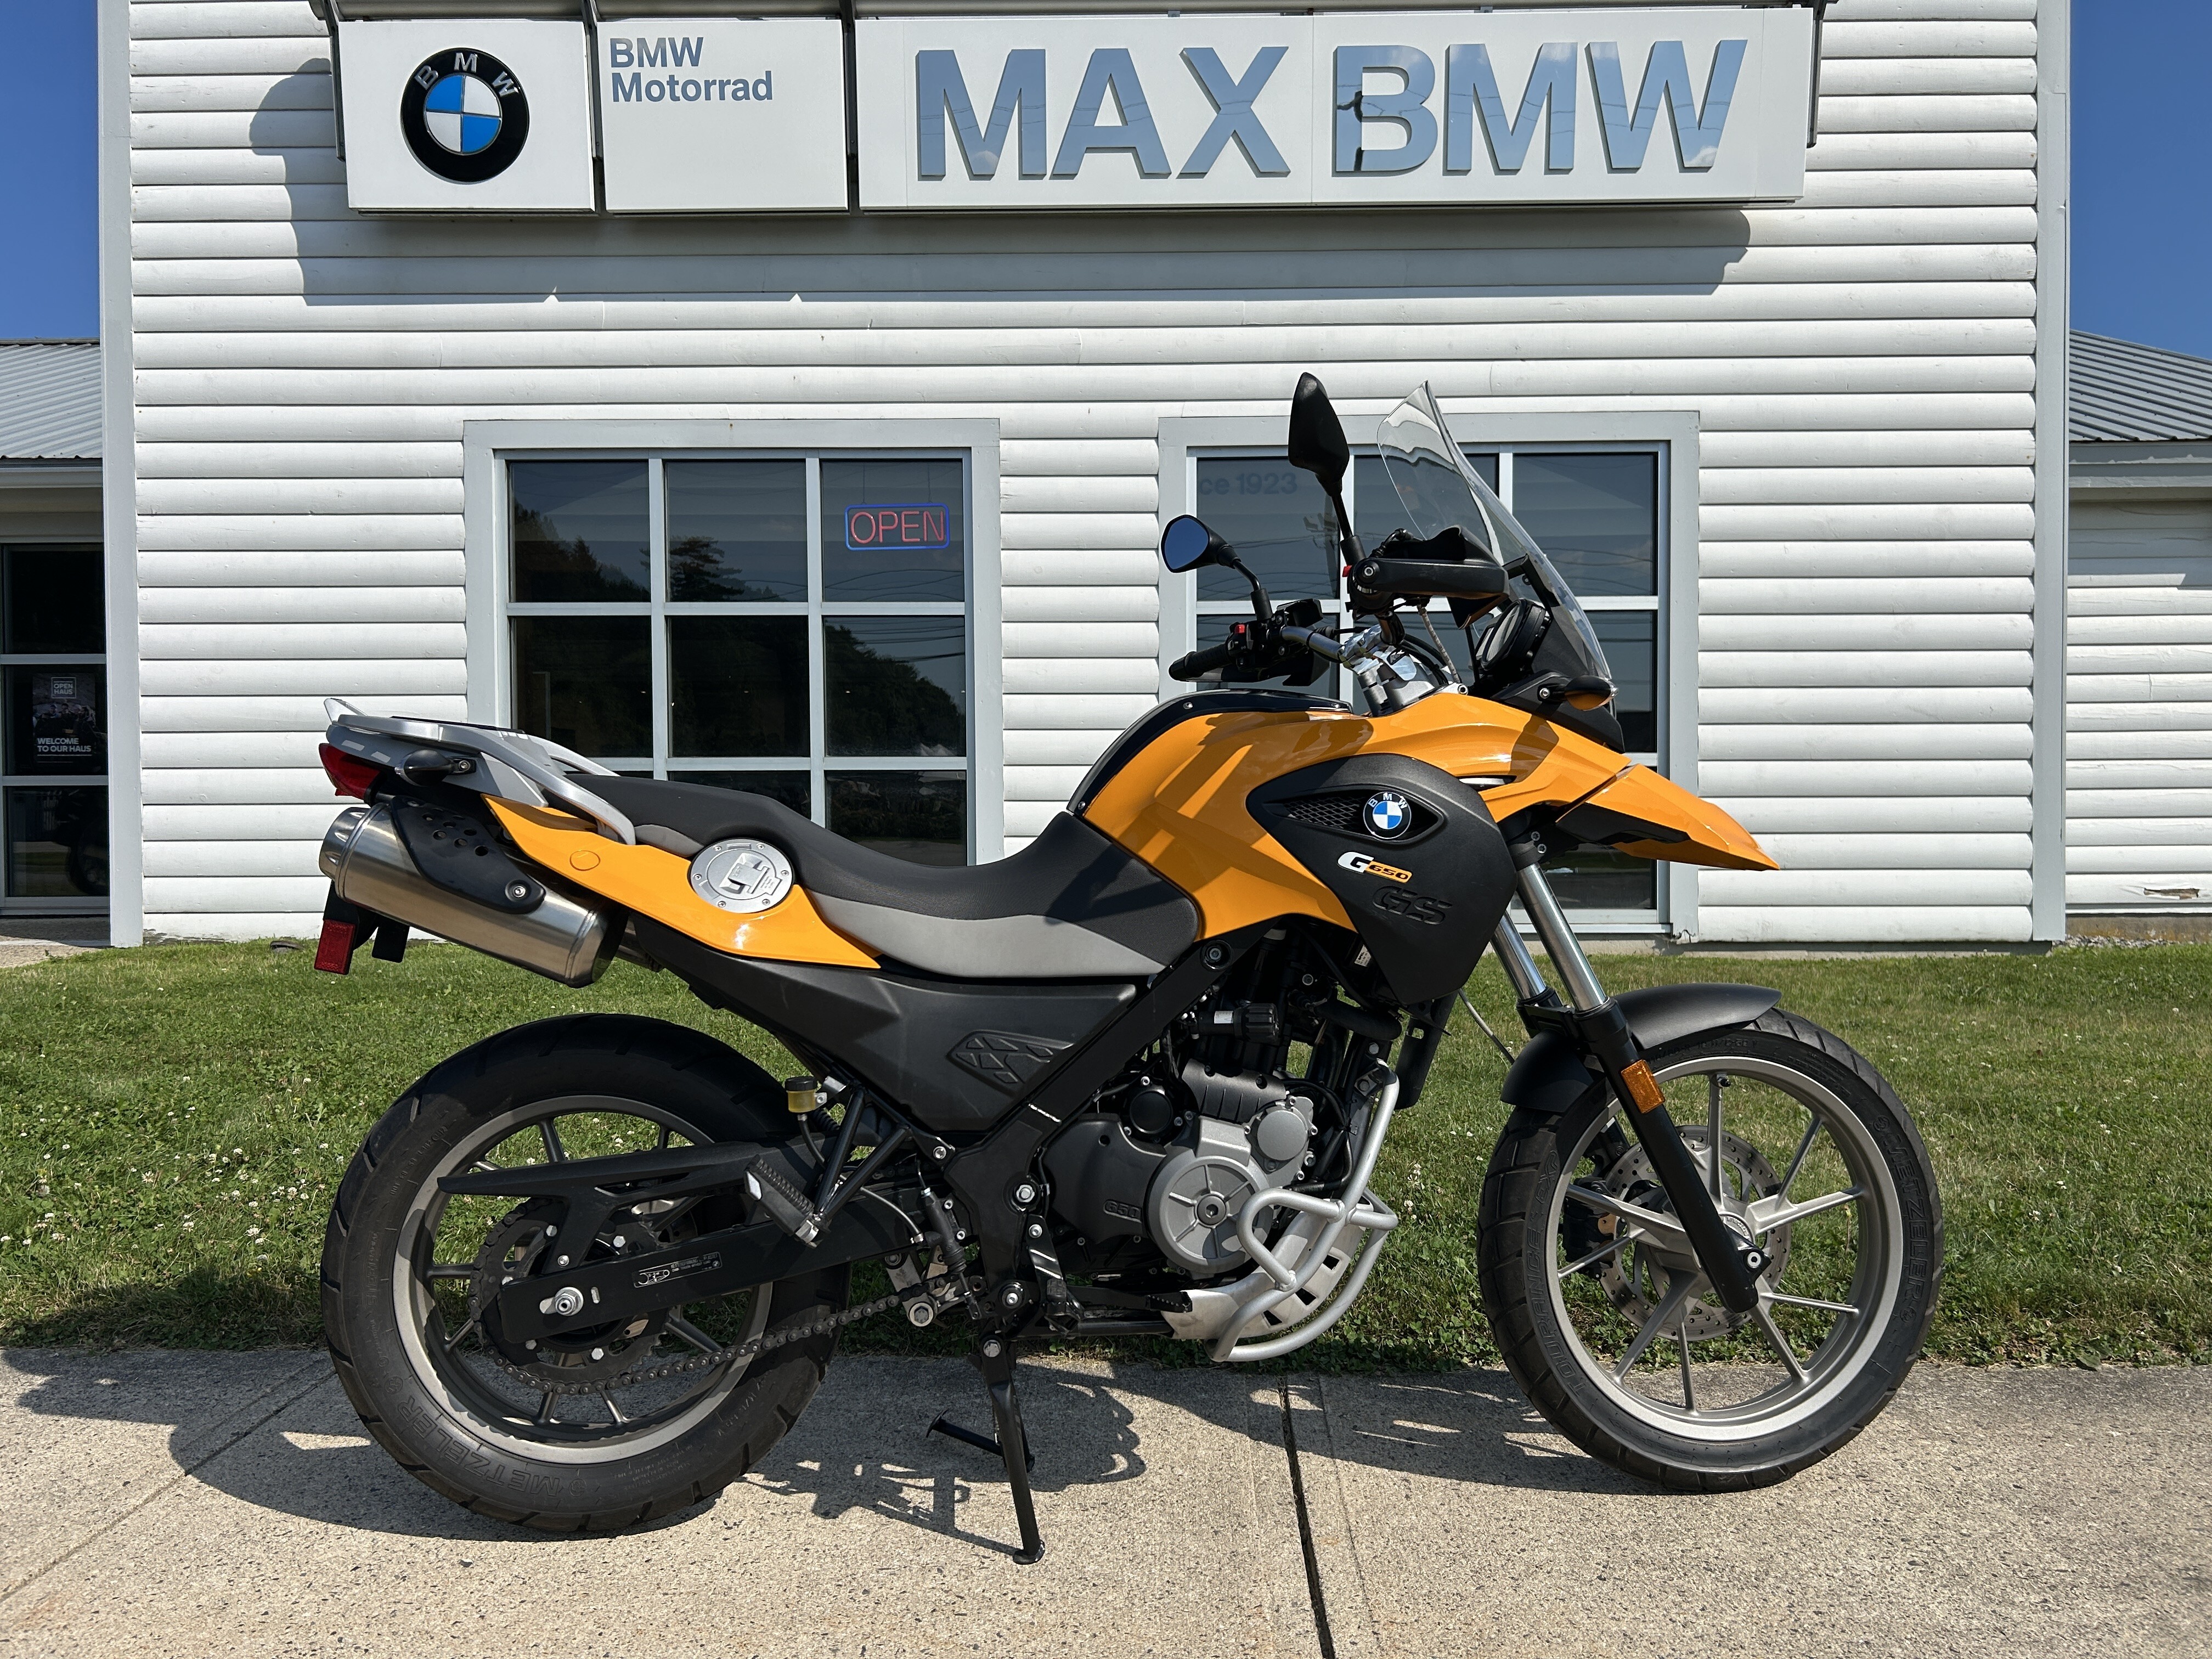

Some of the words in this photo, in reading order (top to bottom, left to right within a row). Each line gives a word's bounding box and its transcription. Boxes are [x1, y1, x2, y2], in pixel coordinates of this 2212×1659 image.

[610, 37, 704, 68] BMW
[415, 52, 518, 98] BMW
[612, 71, 773, 103] Motorrad
[916, 46, 1291, 180] MAX
[1334, 40, 1748, 177] BMW
[1235, 472, 1298, 495] 1923
[850, 511, 944, 544] OPEN
[1368, 792, 1408, 809] BMW
[1373, 885, 1453, 926] GS
[1527, 1228, 1587, 1398] TOURANCE
[397, 1397, 561, 1497] METZELER
